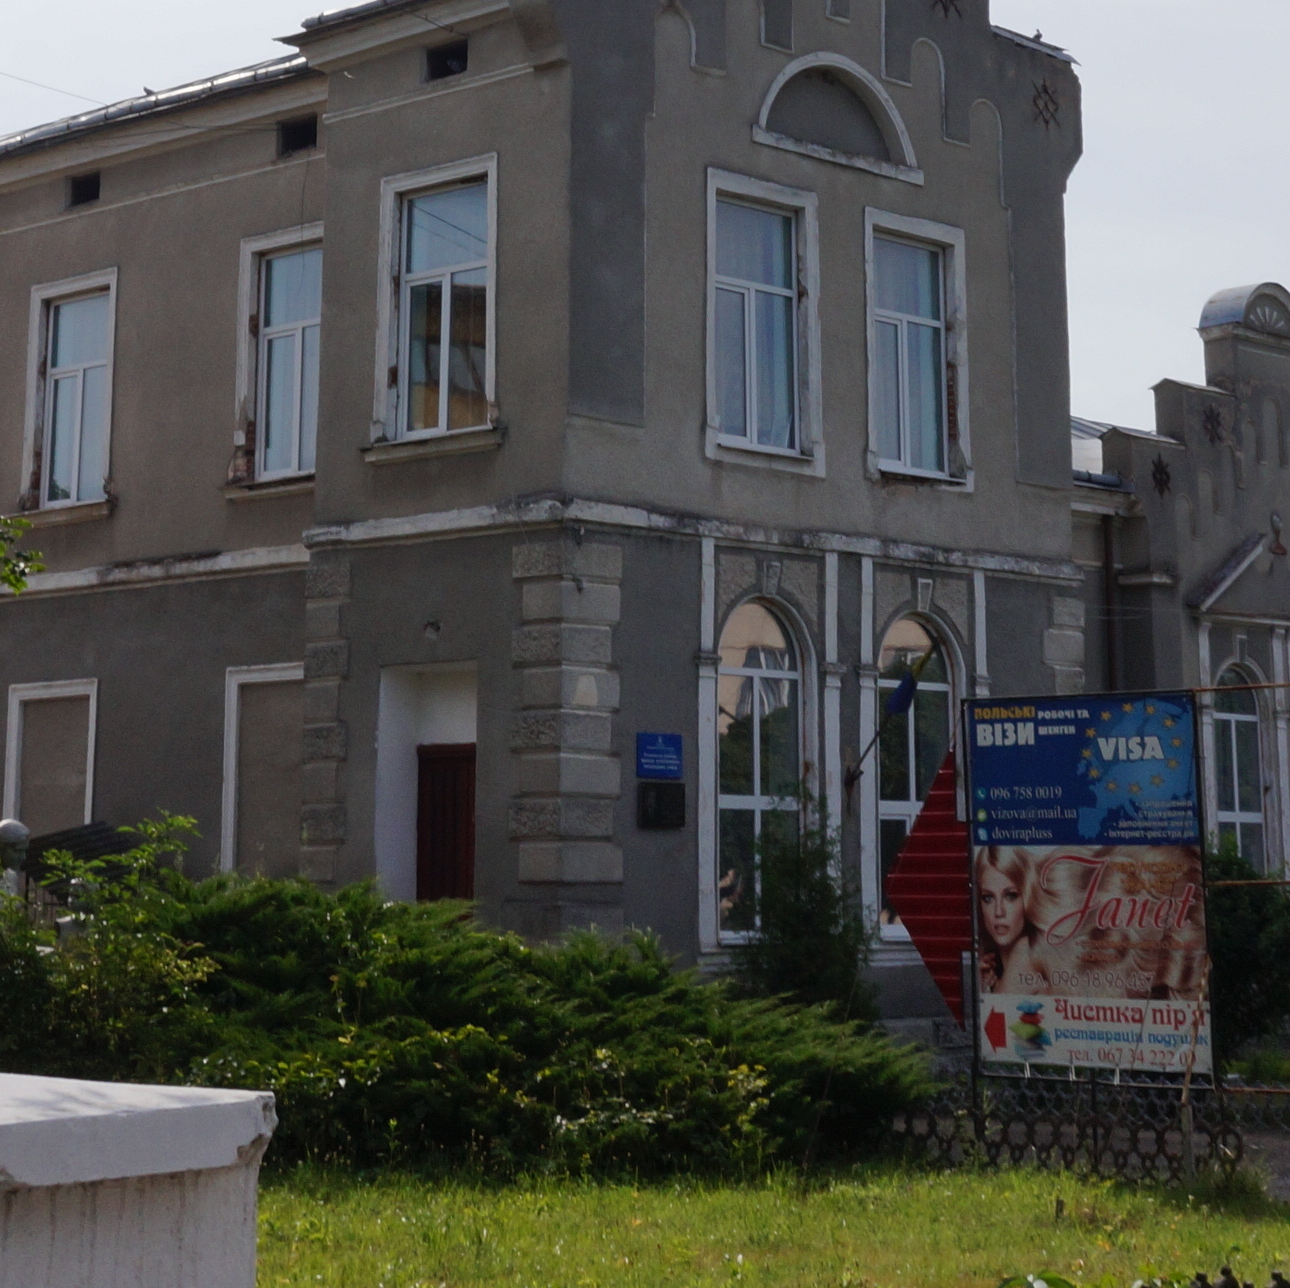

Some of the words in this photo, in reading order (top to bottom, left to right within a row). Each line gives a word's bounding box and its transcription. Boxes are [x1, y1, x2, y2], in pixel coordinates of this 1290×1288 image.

[974, 706, 1035, 720] ПОЛЬСЬКІ
[1038, 710, 1074, 719] РОБОЧІ
[1077, 709, 1090, 718] ТА
[976, 722, 1035, 747] ВІЗИ
[1097, 736, 1165, 762] VISA
[990, 787, 1010, 800] 096
[1013, 786, 1032, 800] 758
[1035, 785, 1062, 800] 0019
[991, 805, 1077, 821] vizova@mail.ua
[1040, 854, 1196, 947] Janet
[1054, 998, 1143, 1024] Чистка
[1097, 1047, 1123, 1063] 067
